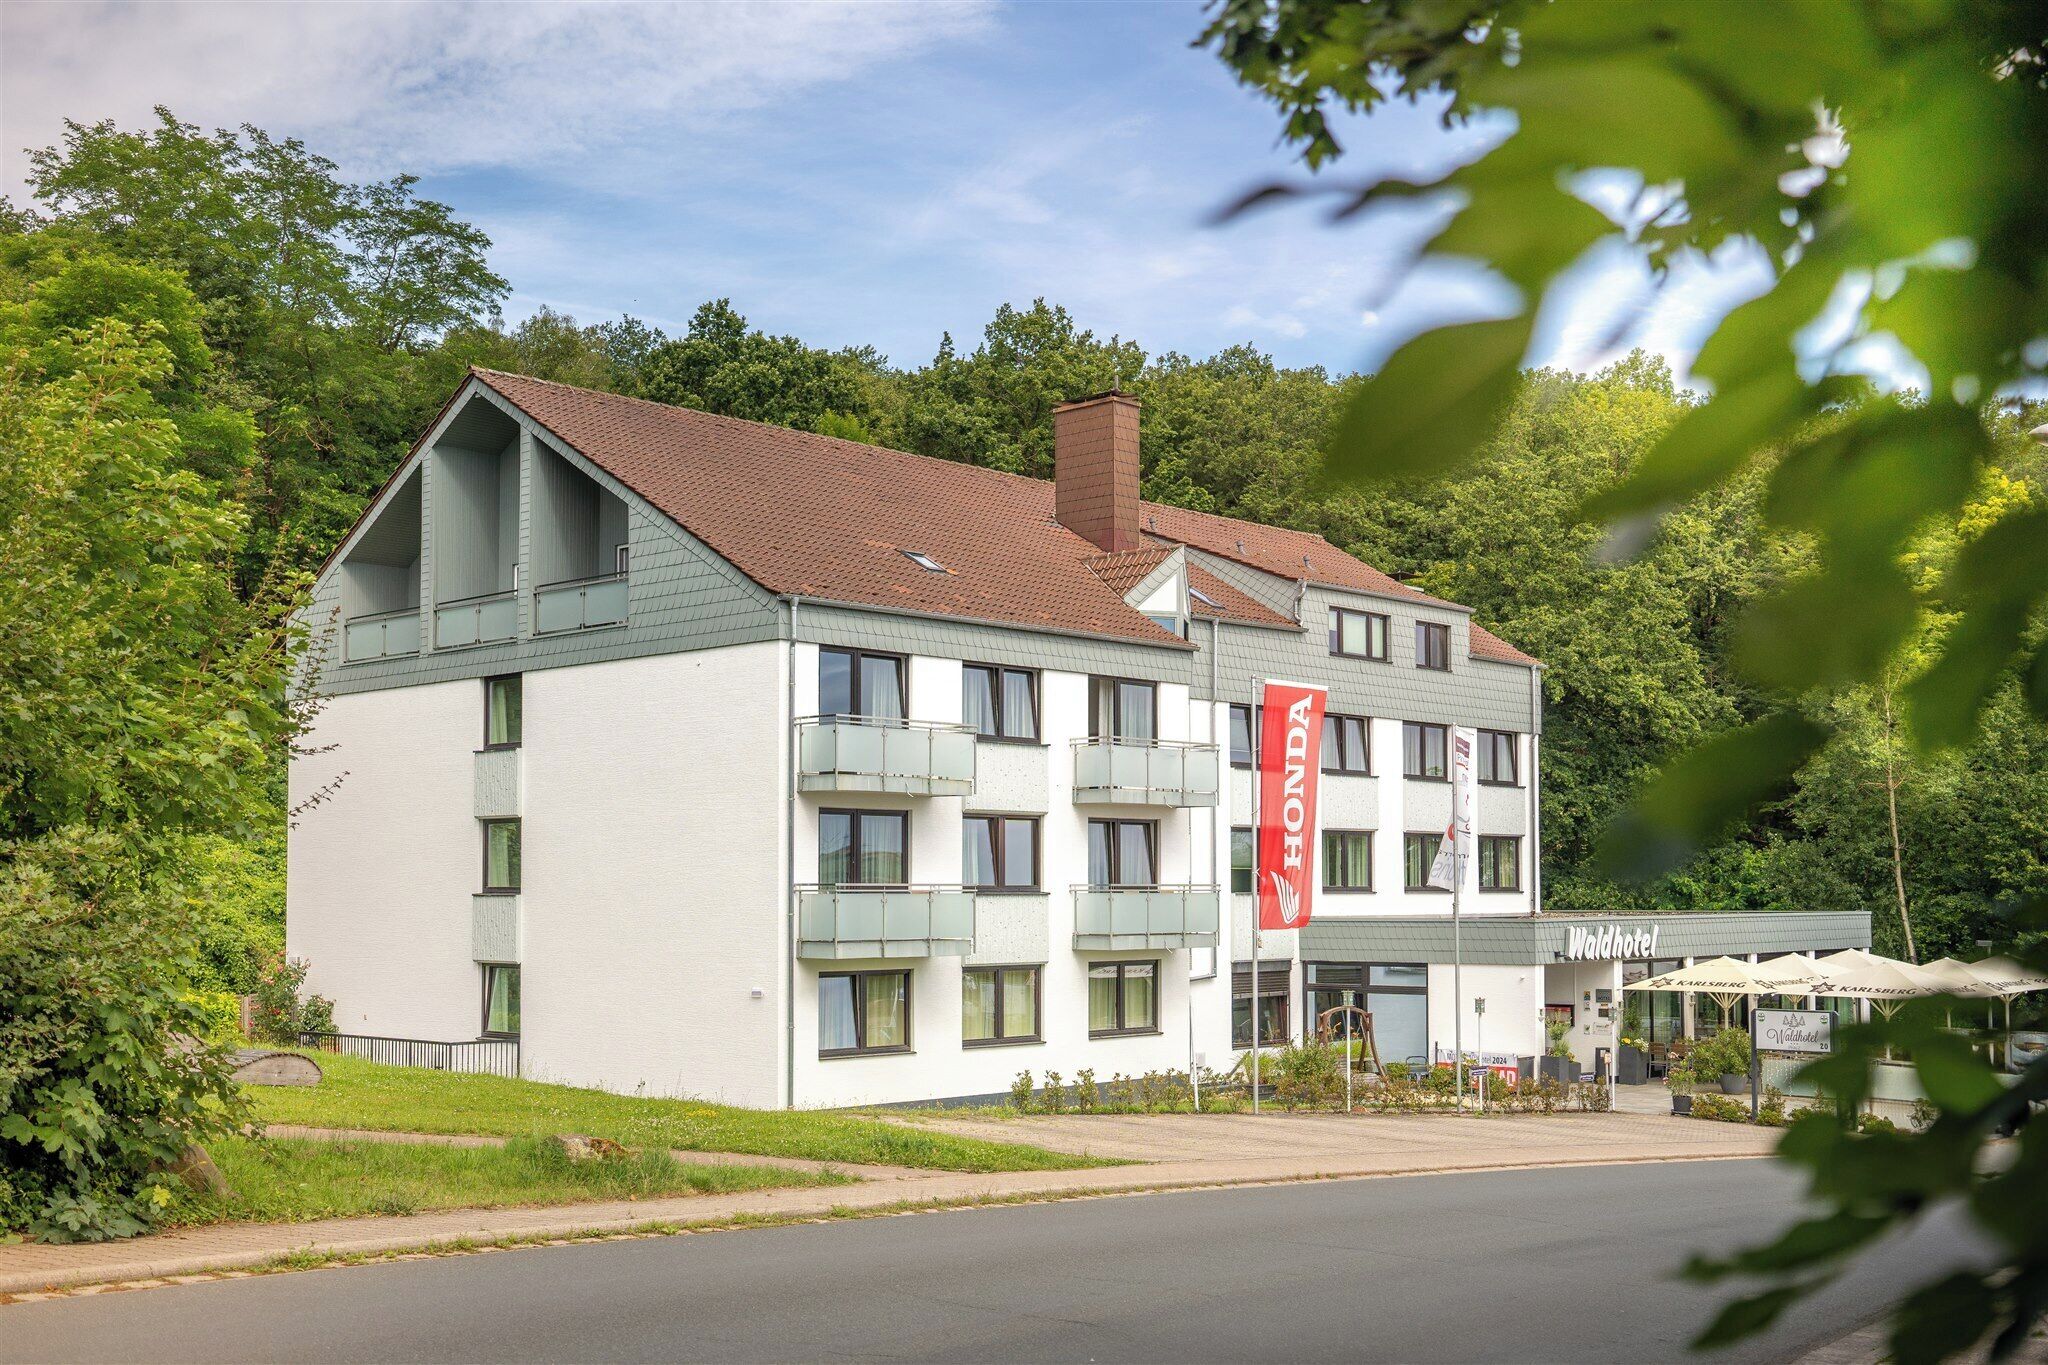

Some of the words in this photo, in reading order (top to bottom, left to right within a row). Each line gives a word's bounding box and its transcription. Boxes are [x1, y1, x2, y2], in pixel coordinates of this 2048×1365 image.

[1283, 693, 1313, 871] HONDA
[1565, 924, 1659, 960] Waldhotel
[1676, 980, 1747, 989] KARLSBERG
[1839, 985, 1917, 995] KARLSBERG
[1766, 1027, 1820, 1045] Waldhotel
[1820, 1042, 1829, 1050] 20
[1492, 1056, 1507, 1065] 2024
